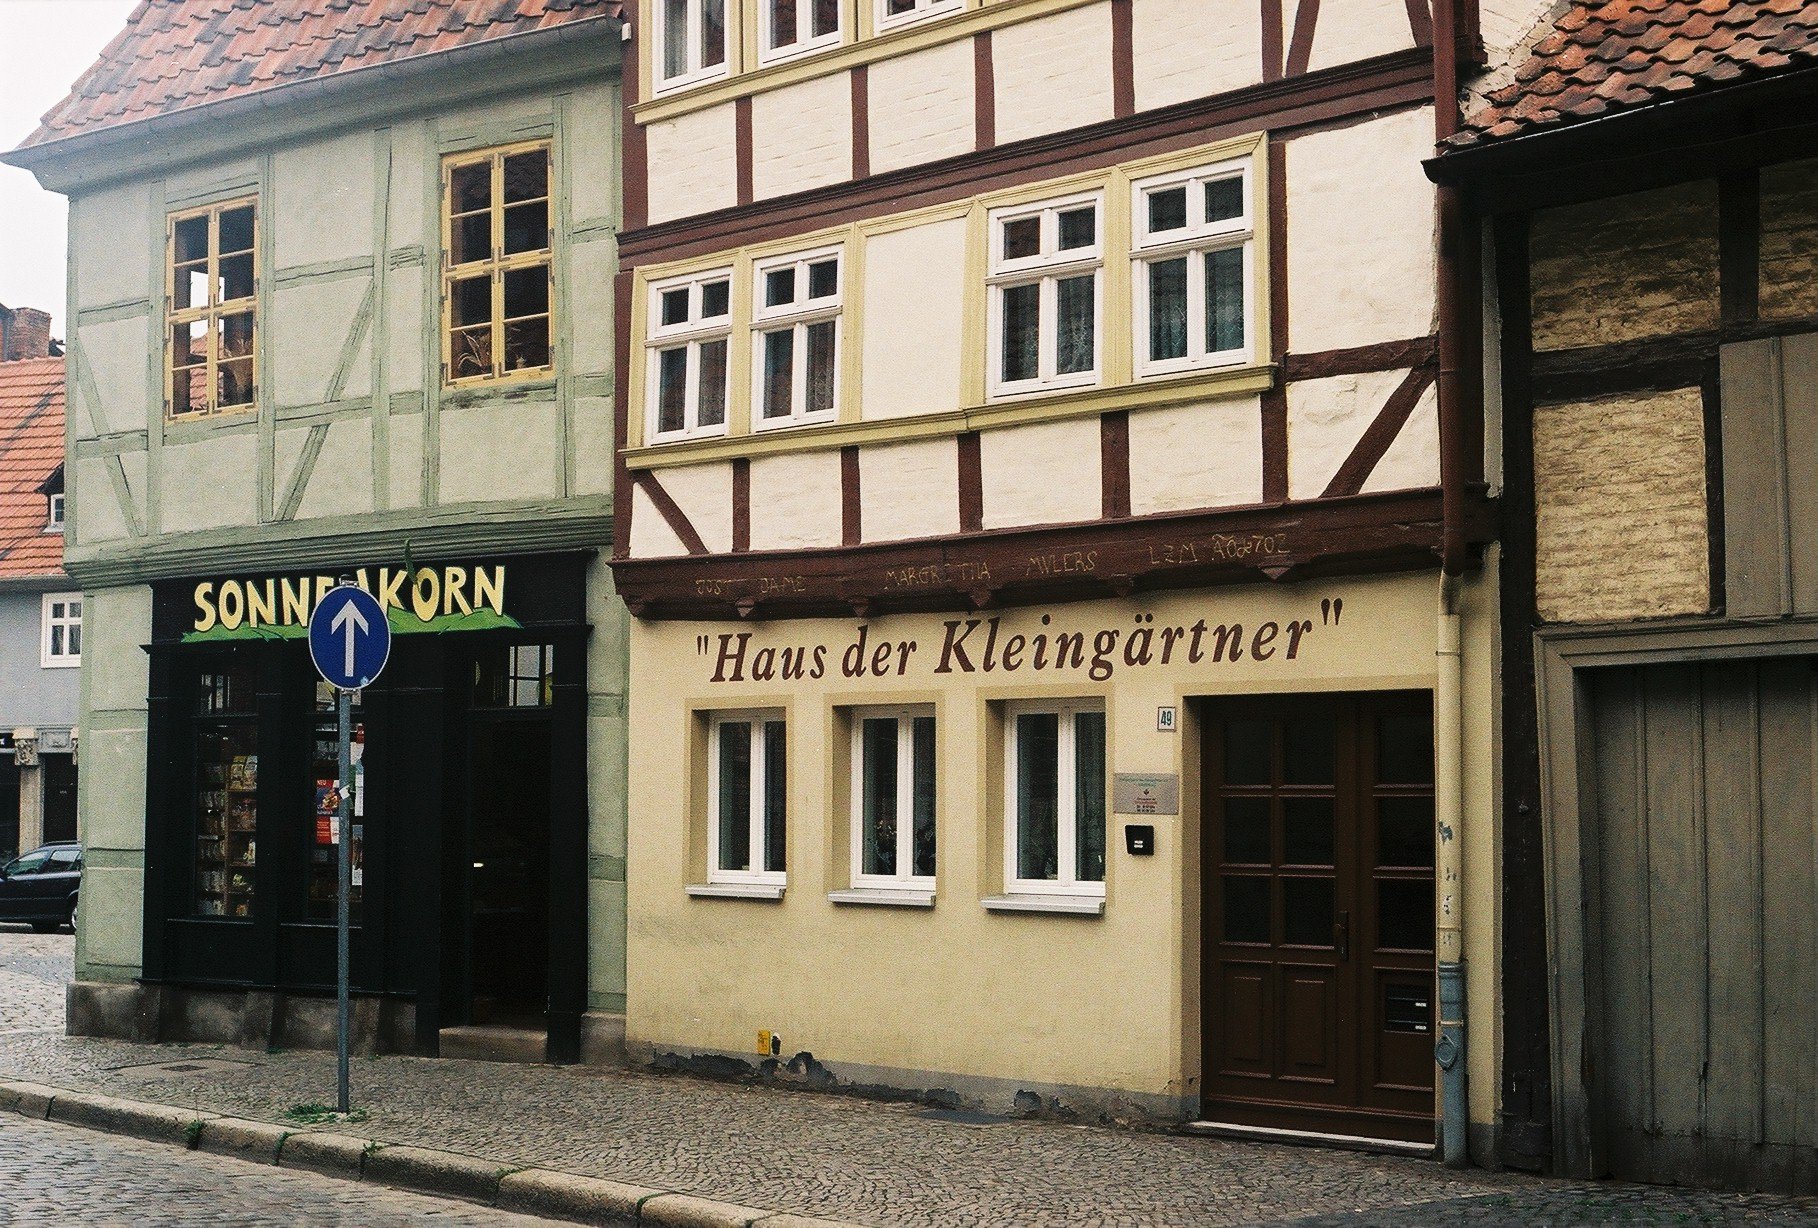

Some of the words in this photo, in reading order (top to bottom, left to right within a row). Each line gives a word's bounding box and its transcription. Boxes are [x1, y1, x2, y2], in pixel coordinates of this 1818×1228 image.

[194, 565, 505, 632] SONNKORN
[696, 632, 827, 683] "Haus
[841, 624, 918, 678] der
[933, 597, 1343, 682] Kleingärtner"
[1160, 710, 1172, 726] 49
